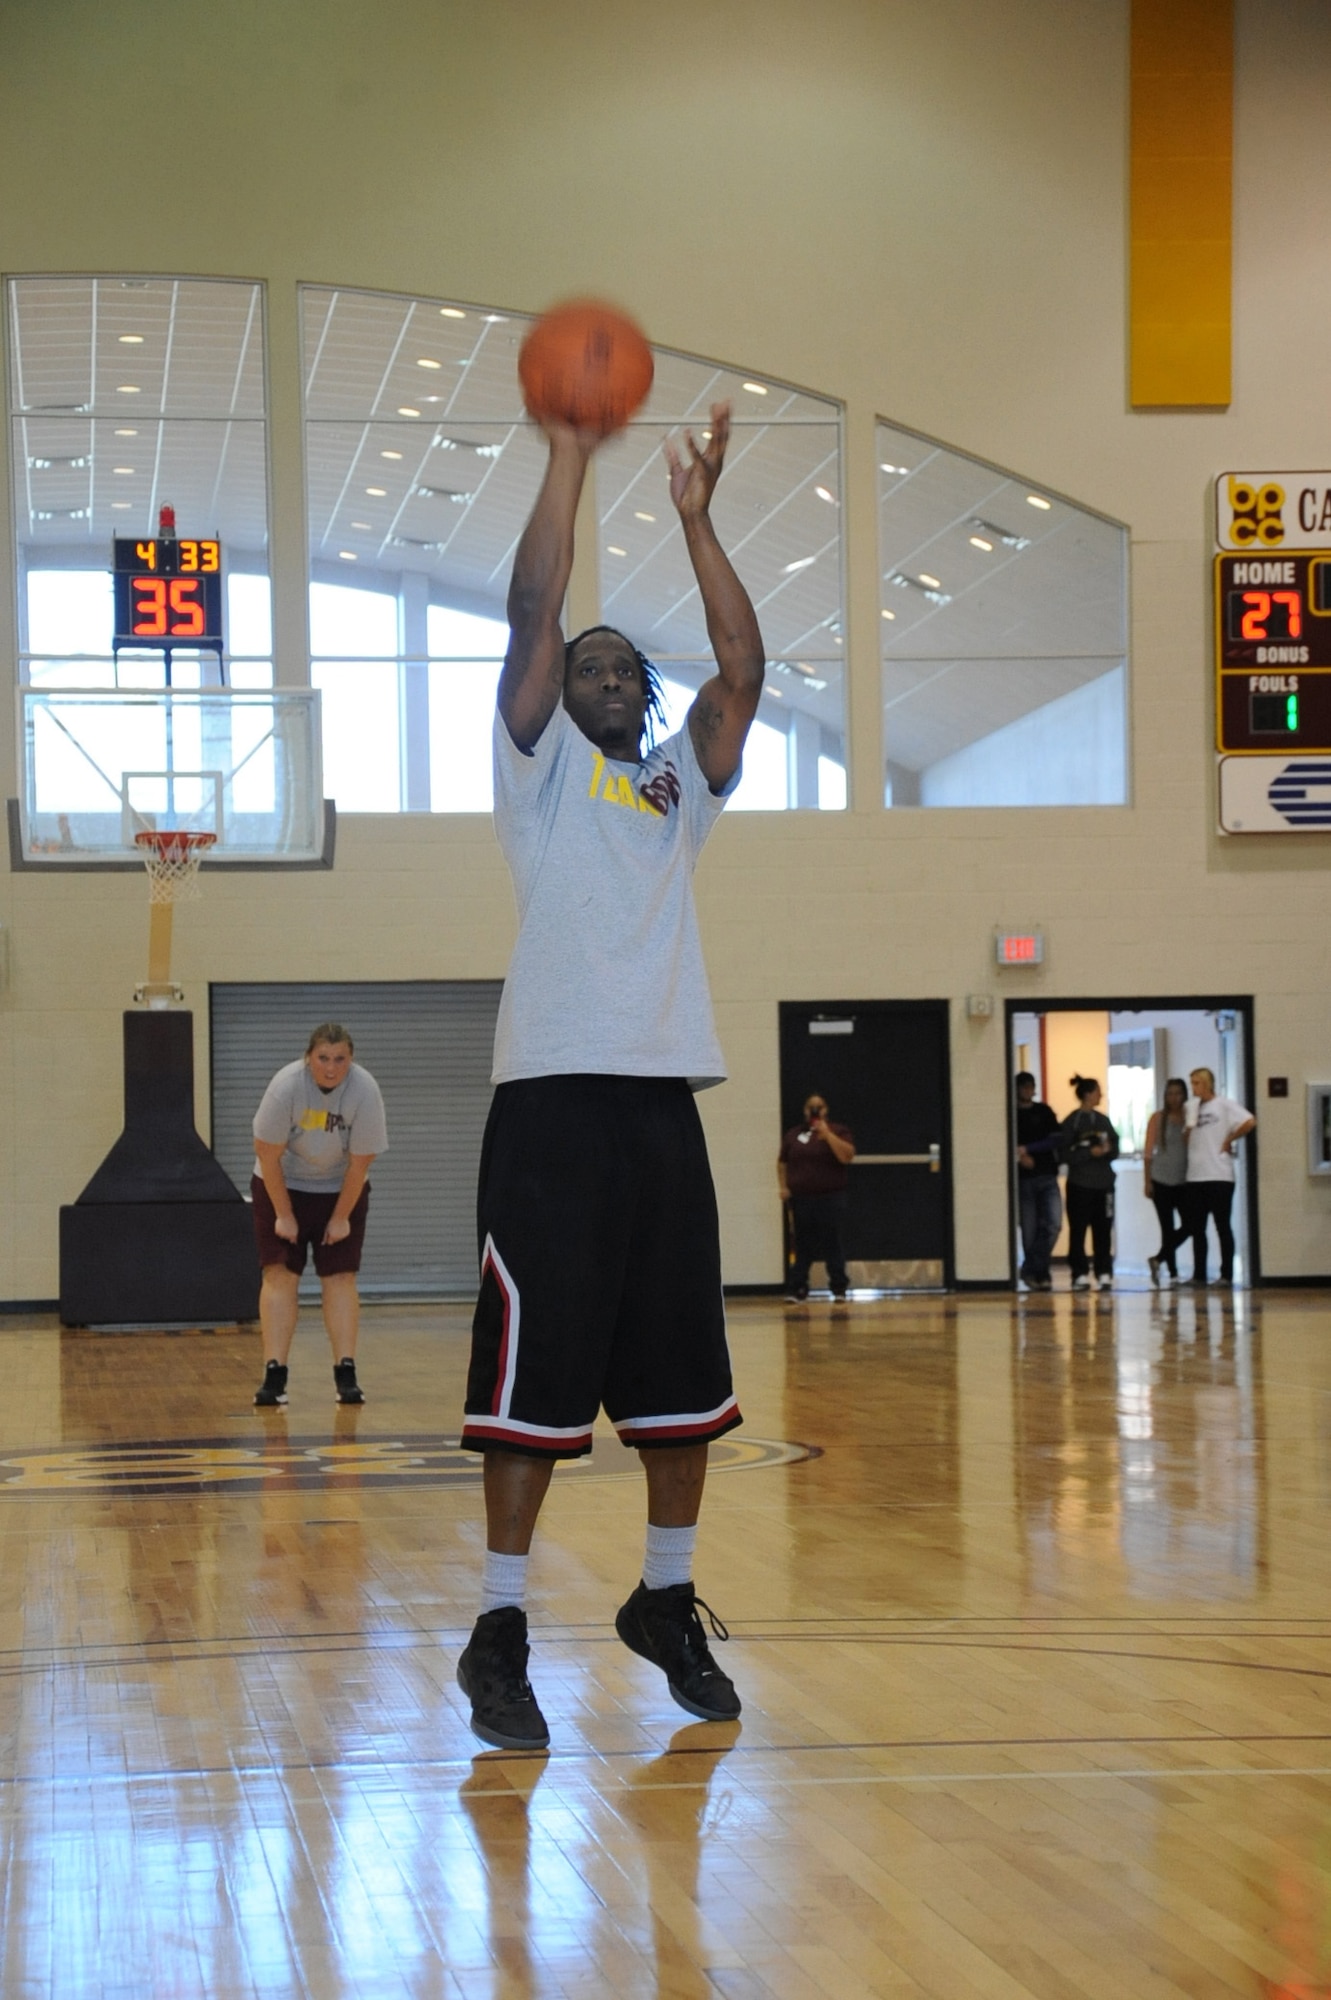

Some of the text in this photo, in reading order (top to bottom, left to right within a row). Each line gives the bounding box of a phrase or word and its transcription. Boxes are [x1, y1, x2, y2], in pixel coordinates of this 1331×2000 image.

[136, 541, 219, 572] 4 33
[1233, 562, 1296, 585] HOME
[133, 578, 205, 636] 35
[1241, 592, 1300, 640] 27
[1256, 646, 1310, 664] BONUS
[1249, 675, 1299, 693] FOULS
[1286, 694, 1298, 732] 1
